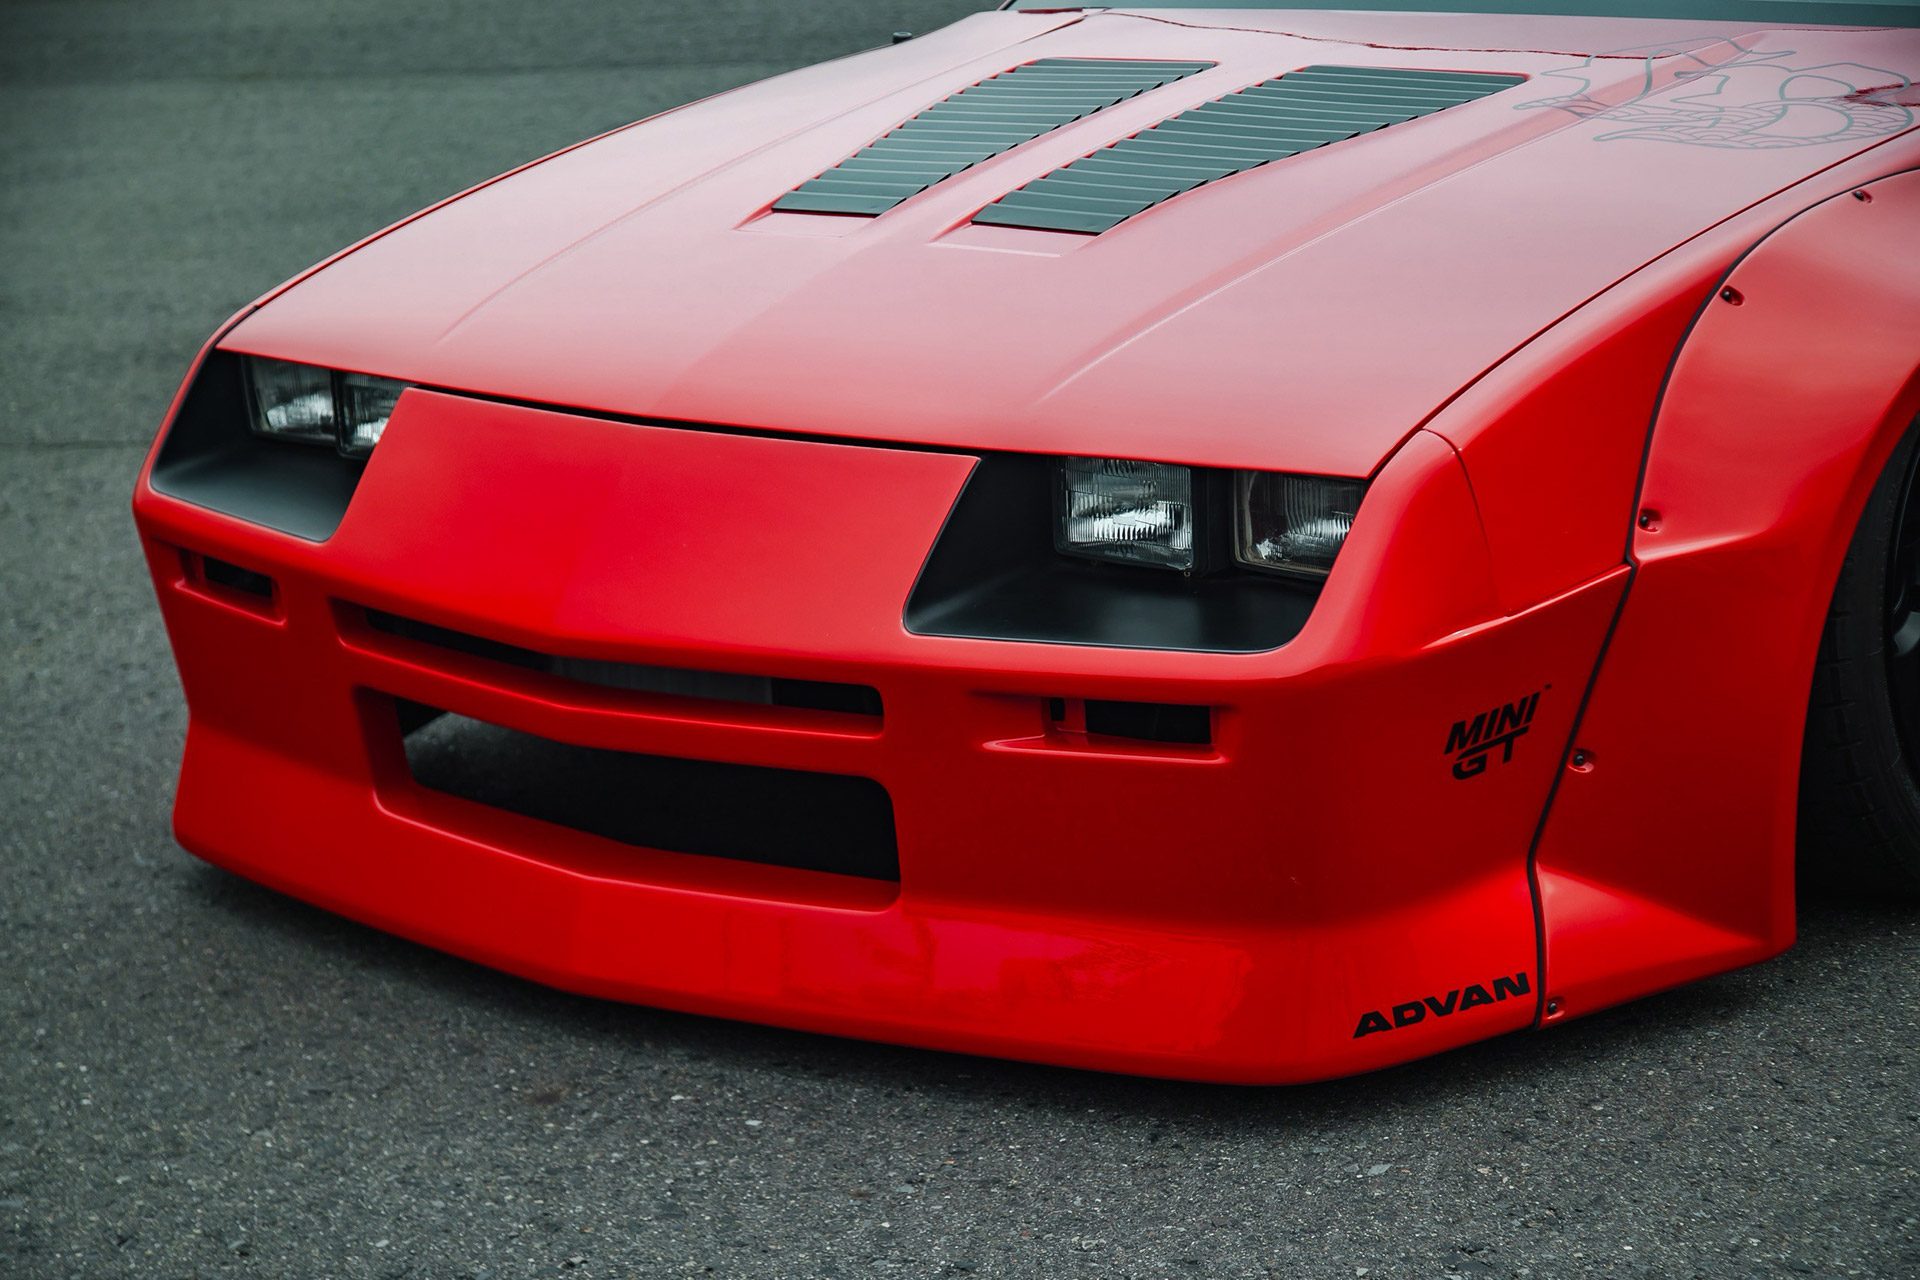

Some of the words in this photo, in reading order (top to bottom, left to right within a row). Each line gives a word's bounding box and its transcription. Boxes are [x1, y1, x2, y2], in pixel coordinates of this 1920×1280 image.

[1444, 691, 1541, 755] MINI
[1452, 725, 1530, 780] GT
[1353, 972, 1531, 1039] ADVAN
